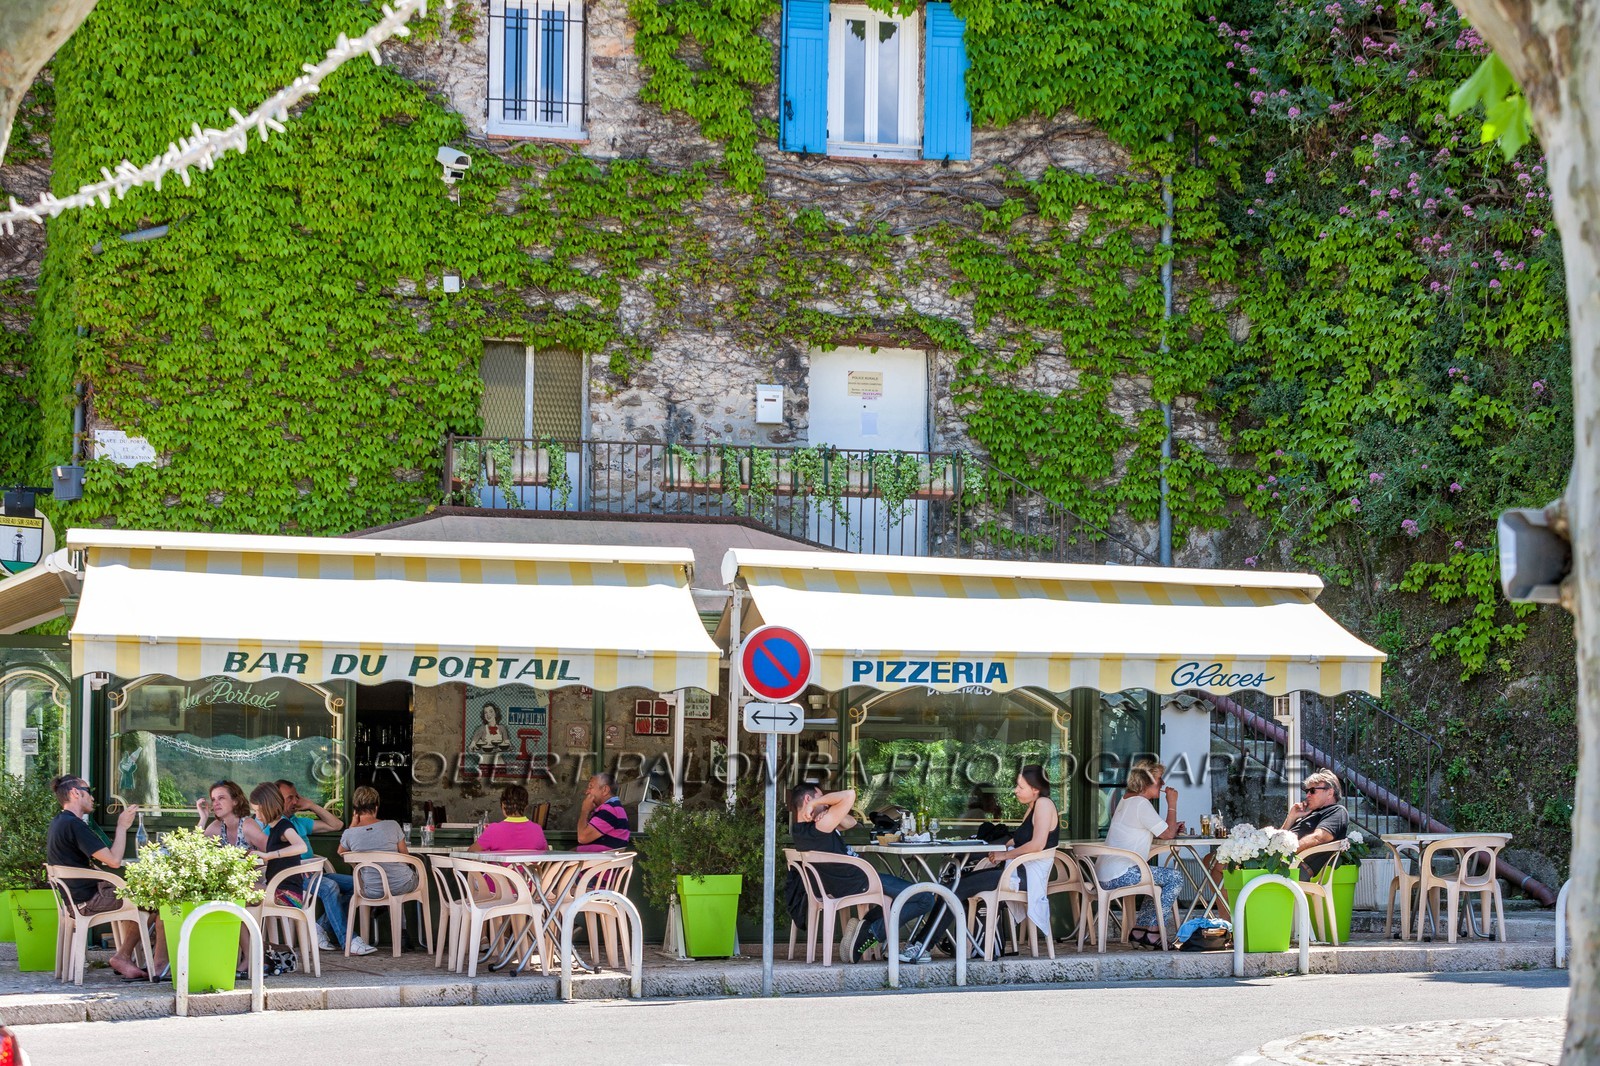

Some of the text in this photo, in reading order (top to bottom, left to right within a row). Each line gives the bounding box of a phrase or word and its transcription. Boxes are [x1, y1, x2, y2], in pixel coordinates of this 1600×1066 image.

[222, 651, 580, 681] BAR DU PORTAIL
[852, 660, 1008, 684] PIZZERIA
[1171, 662, 1275, 687] Glaces
[179, 681, 280, 710] du Portail
